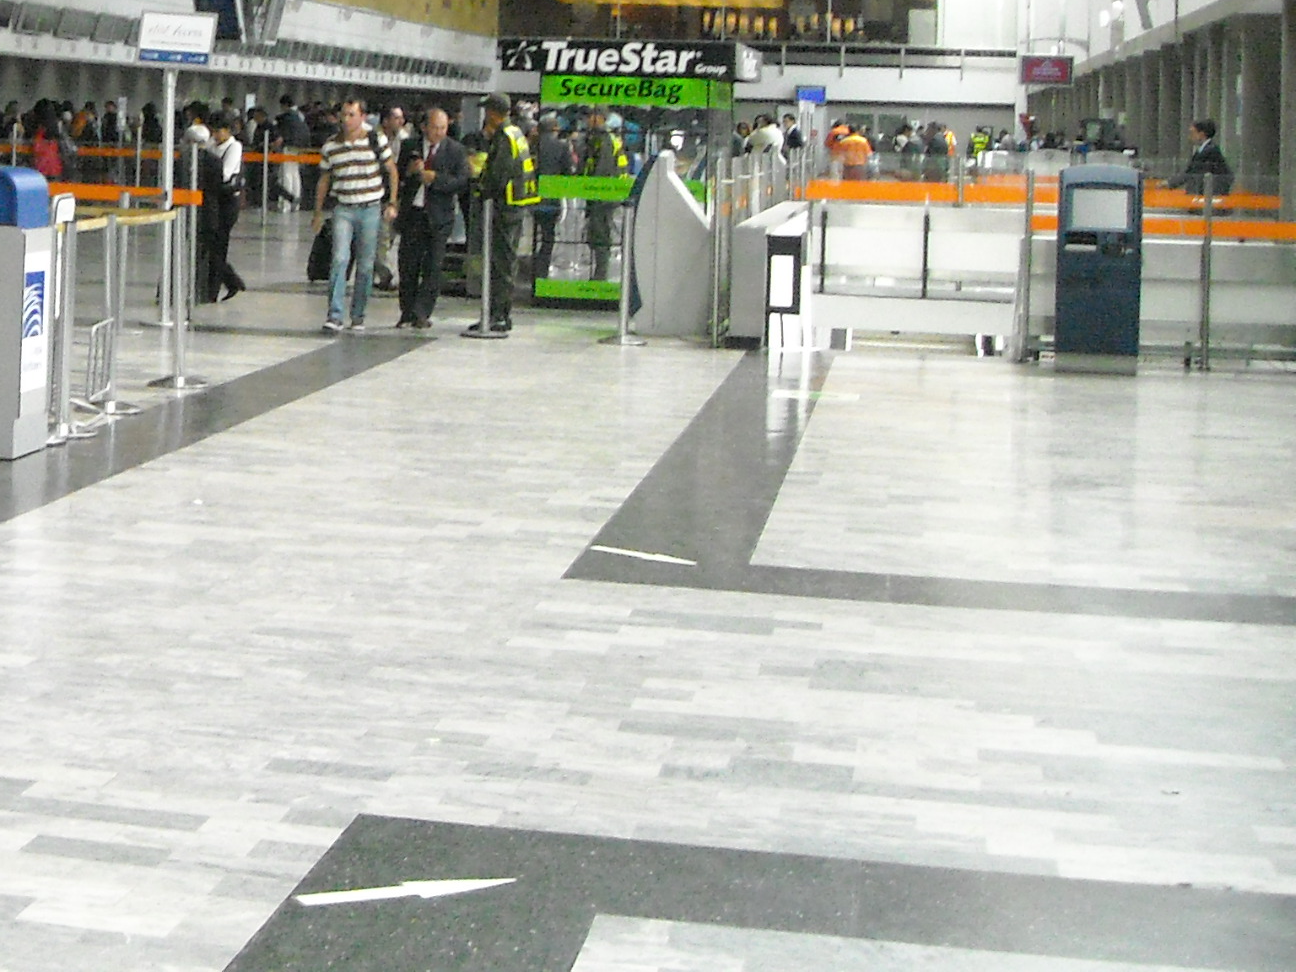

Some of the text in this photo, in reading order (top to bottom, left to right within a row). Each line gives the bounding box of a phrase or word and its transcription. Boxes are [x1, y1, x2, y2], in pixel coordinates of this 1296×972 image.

[542, 41, 696, 75] TrueStar
[695, 64, 727, 76] Group
[560, 79, 683, 104] SecureBag
